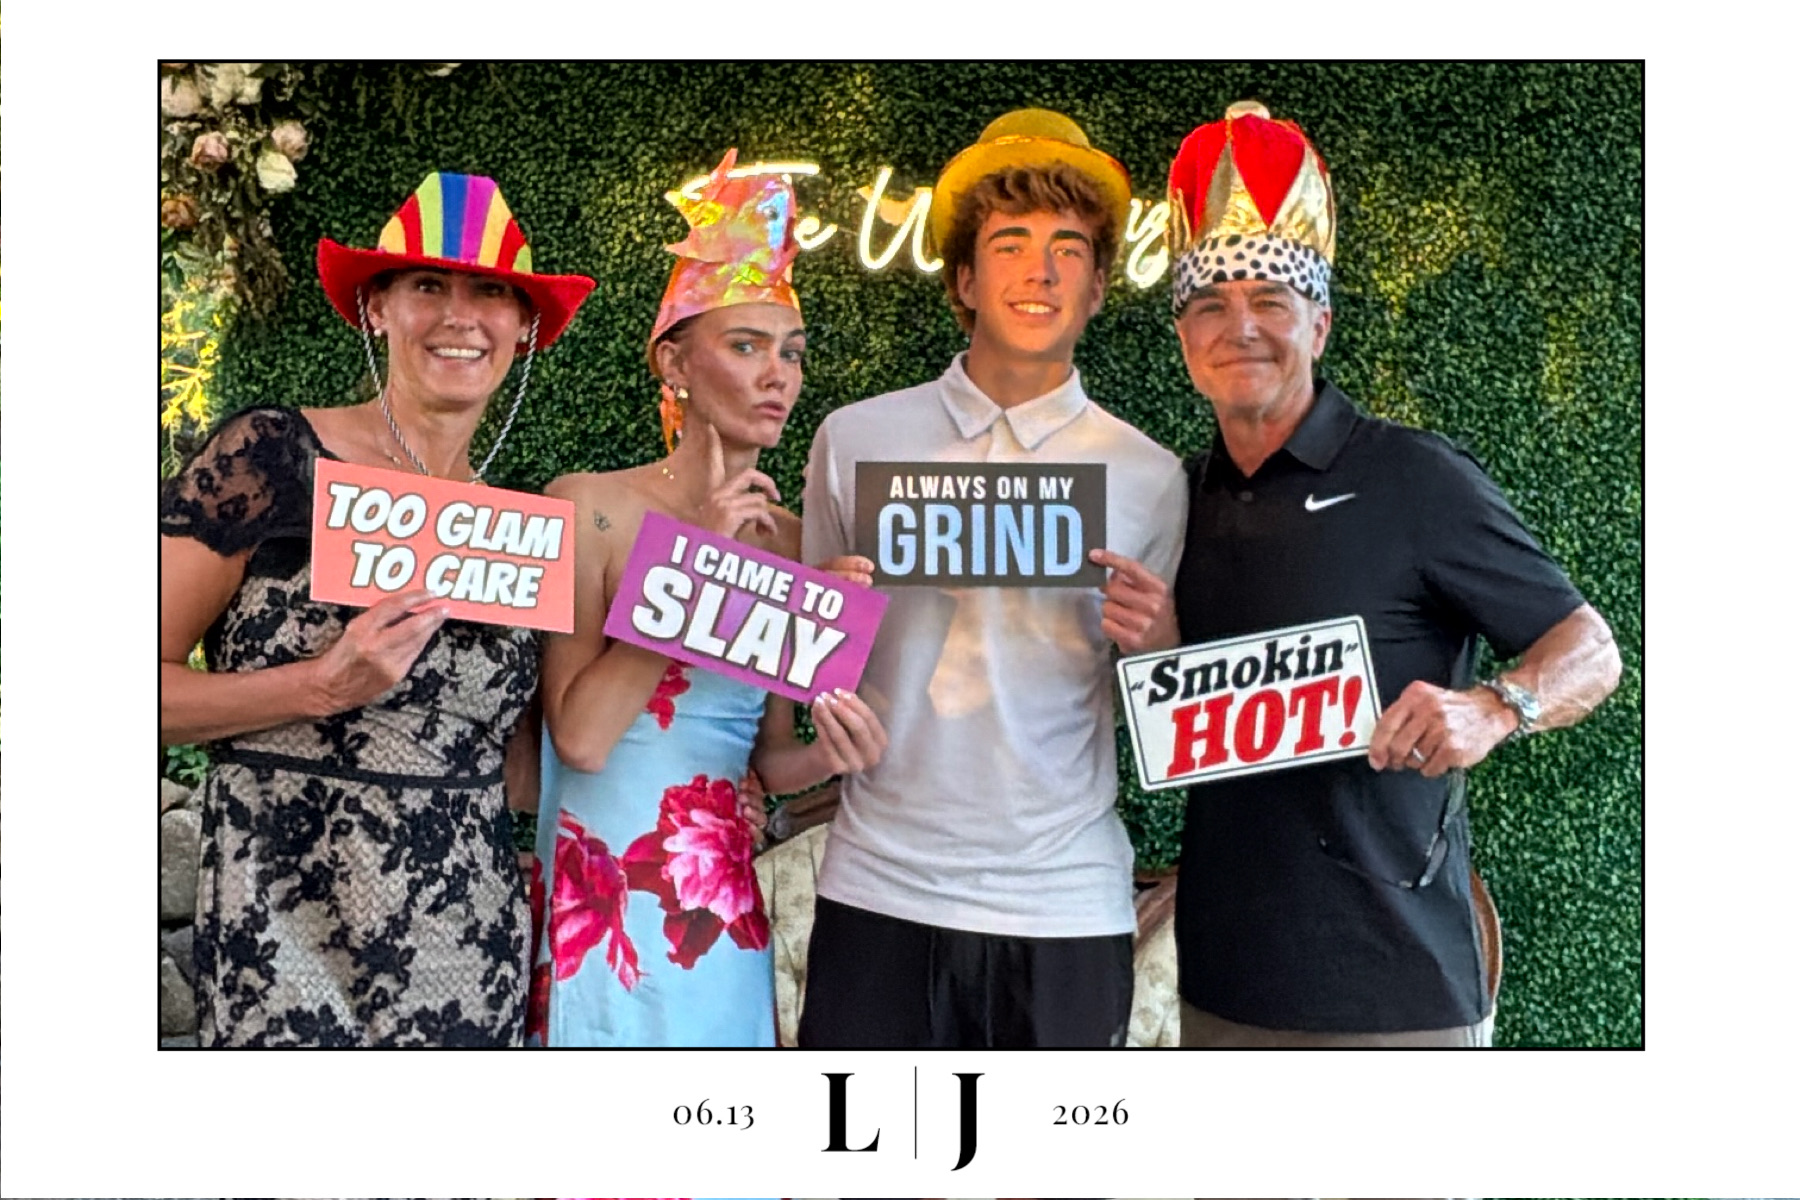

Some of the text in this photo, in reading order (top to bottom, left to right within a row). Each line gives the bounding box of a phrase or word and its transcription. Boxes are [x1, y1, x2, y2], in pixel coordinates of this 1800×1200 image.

[327, 481, 565, 560] TOO GLAM
[890, 475, 1074, 500] ALWAYS ON MY
[351, 540, 545, 609] TO CARE
[671, 534, 844, 621] I CAME TO
[878, 503, 1083, 576] GRIND
[631, 565, 848, 690] SLAY
[1167, 675, 1362, 779] HOT!
